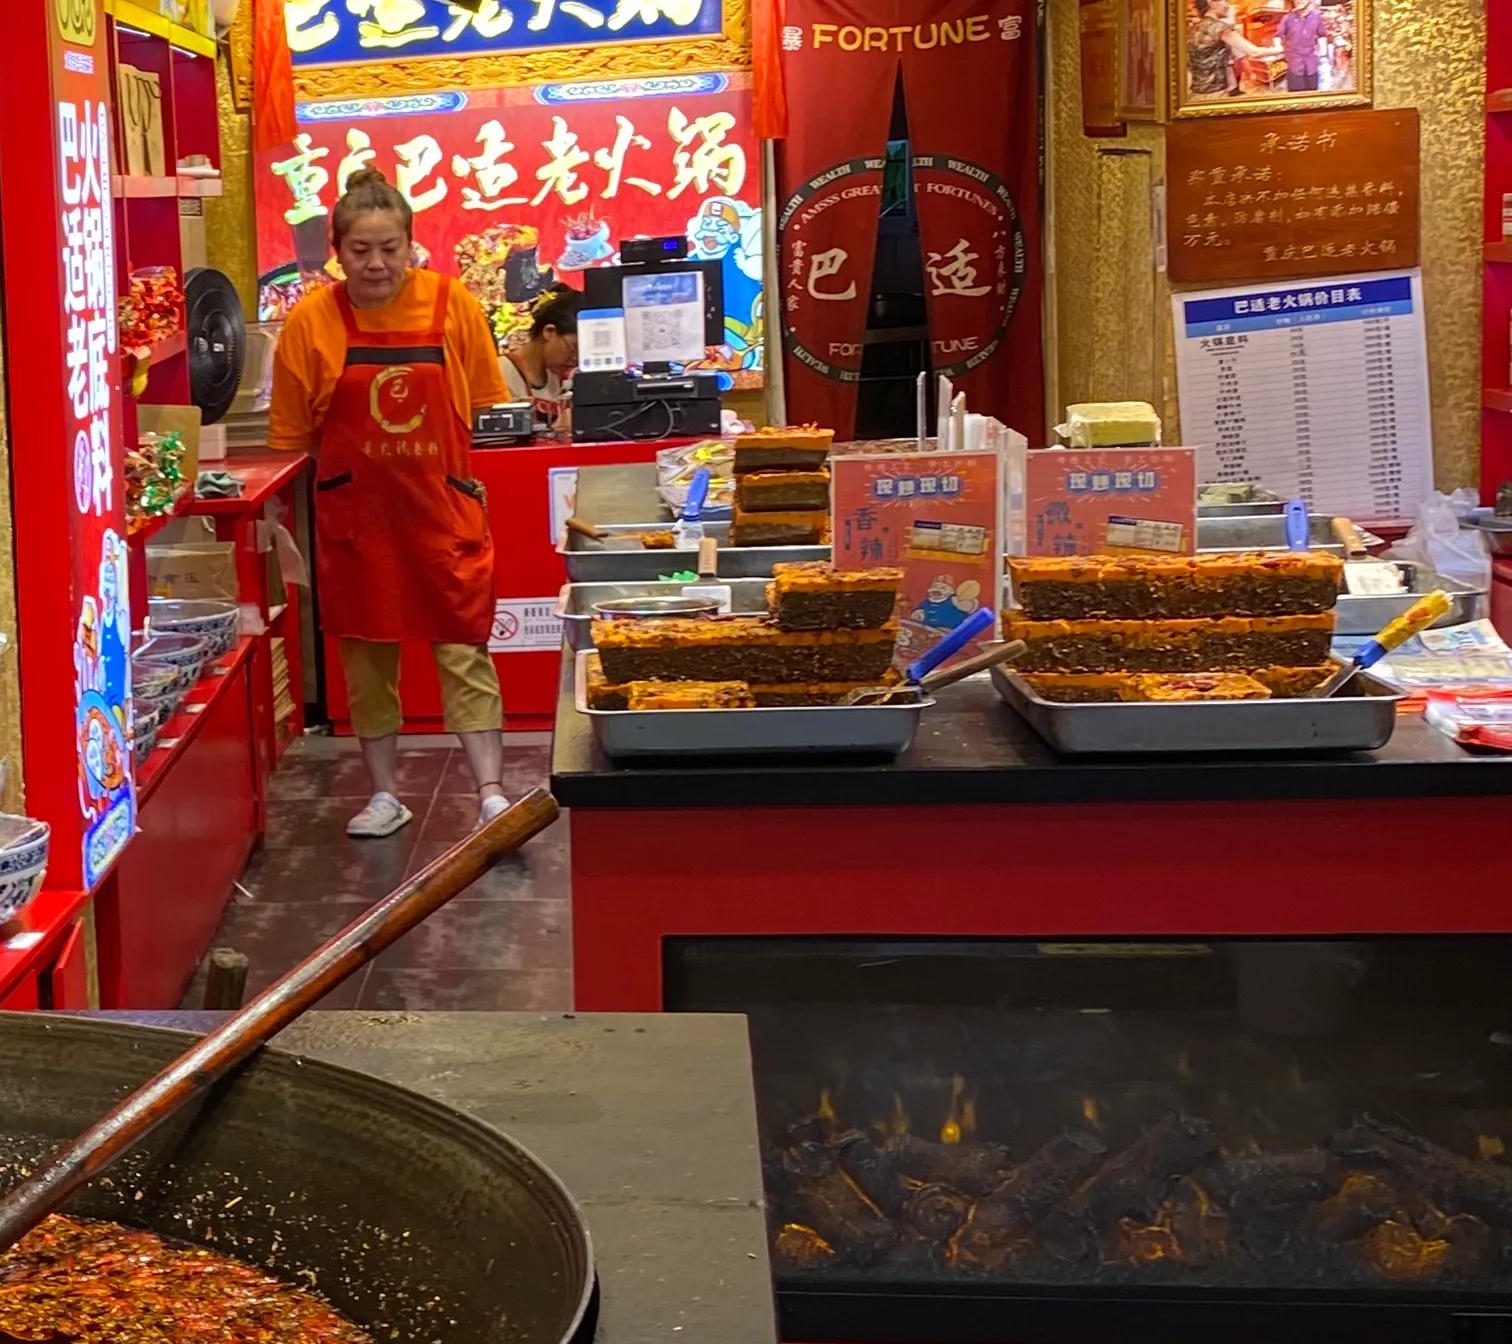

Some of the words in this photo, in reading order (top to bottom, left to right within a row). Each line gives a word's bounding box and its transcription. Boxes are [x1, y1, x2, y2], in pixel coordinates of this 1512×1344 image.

[812, 14, 991, 53] FORTUNE
[809, 164, 851, 189] WEALTH
[947, 159, 990, 183] WEALTH
[927, 182, 998, 216] FORTUNES
[807, 247, 857, 301] 巴
[924, 238, 993, 297] 适
[1234, 287, 1363, 314] 巴适老火锅价目表
